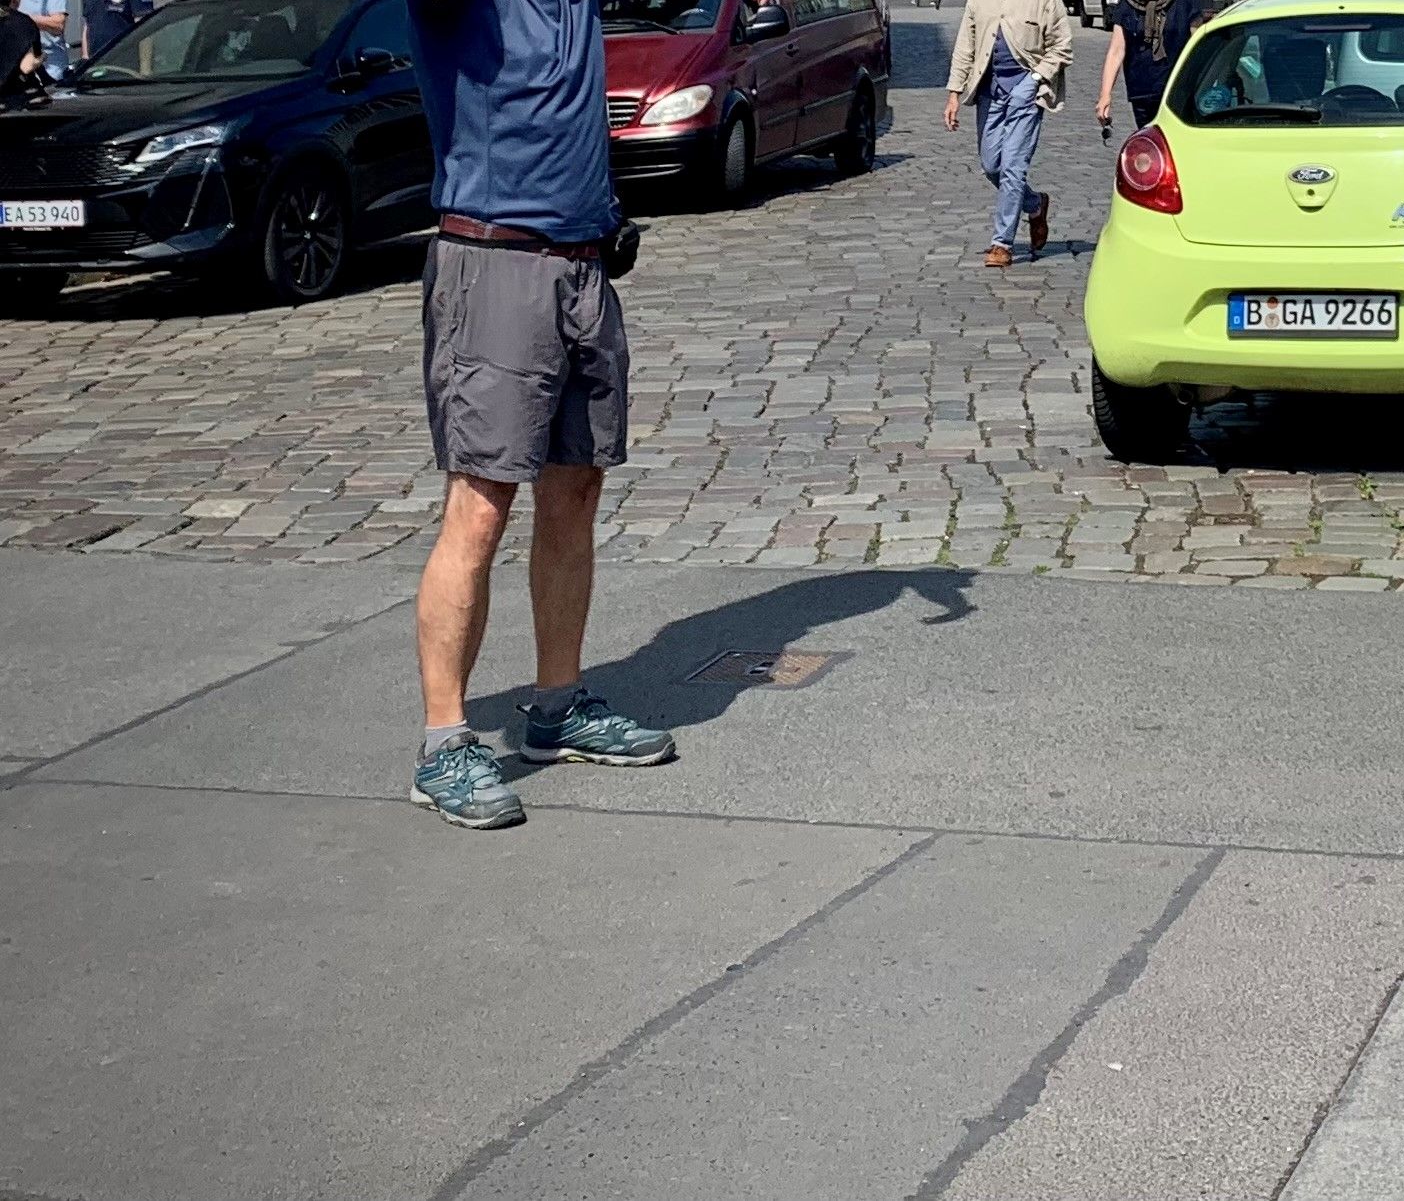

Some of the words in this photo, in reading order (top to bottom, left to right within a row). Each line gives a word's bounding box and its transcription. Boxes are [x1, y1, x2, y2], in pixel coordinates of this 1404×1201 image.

[5, 207, 24, 222] EA
[29, 207, 46, 222] 53
[51, 206, 79, 222] 940
[1246, 299, 1263, 326] B
[1282, 298, 1316, 326] GA
[1324, 298, 1393, 326] 9266
